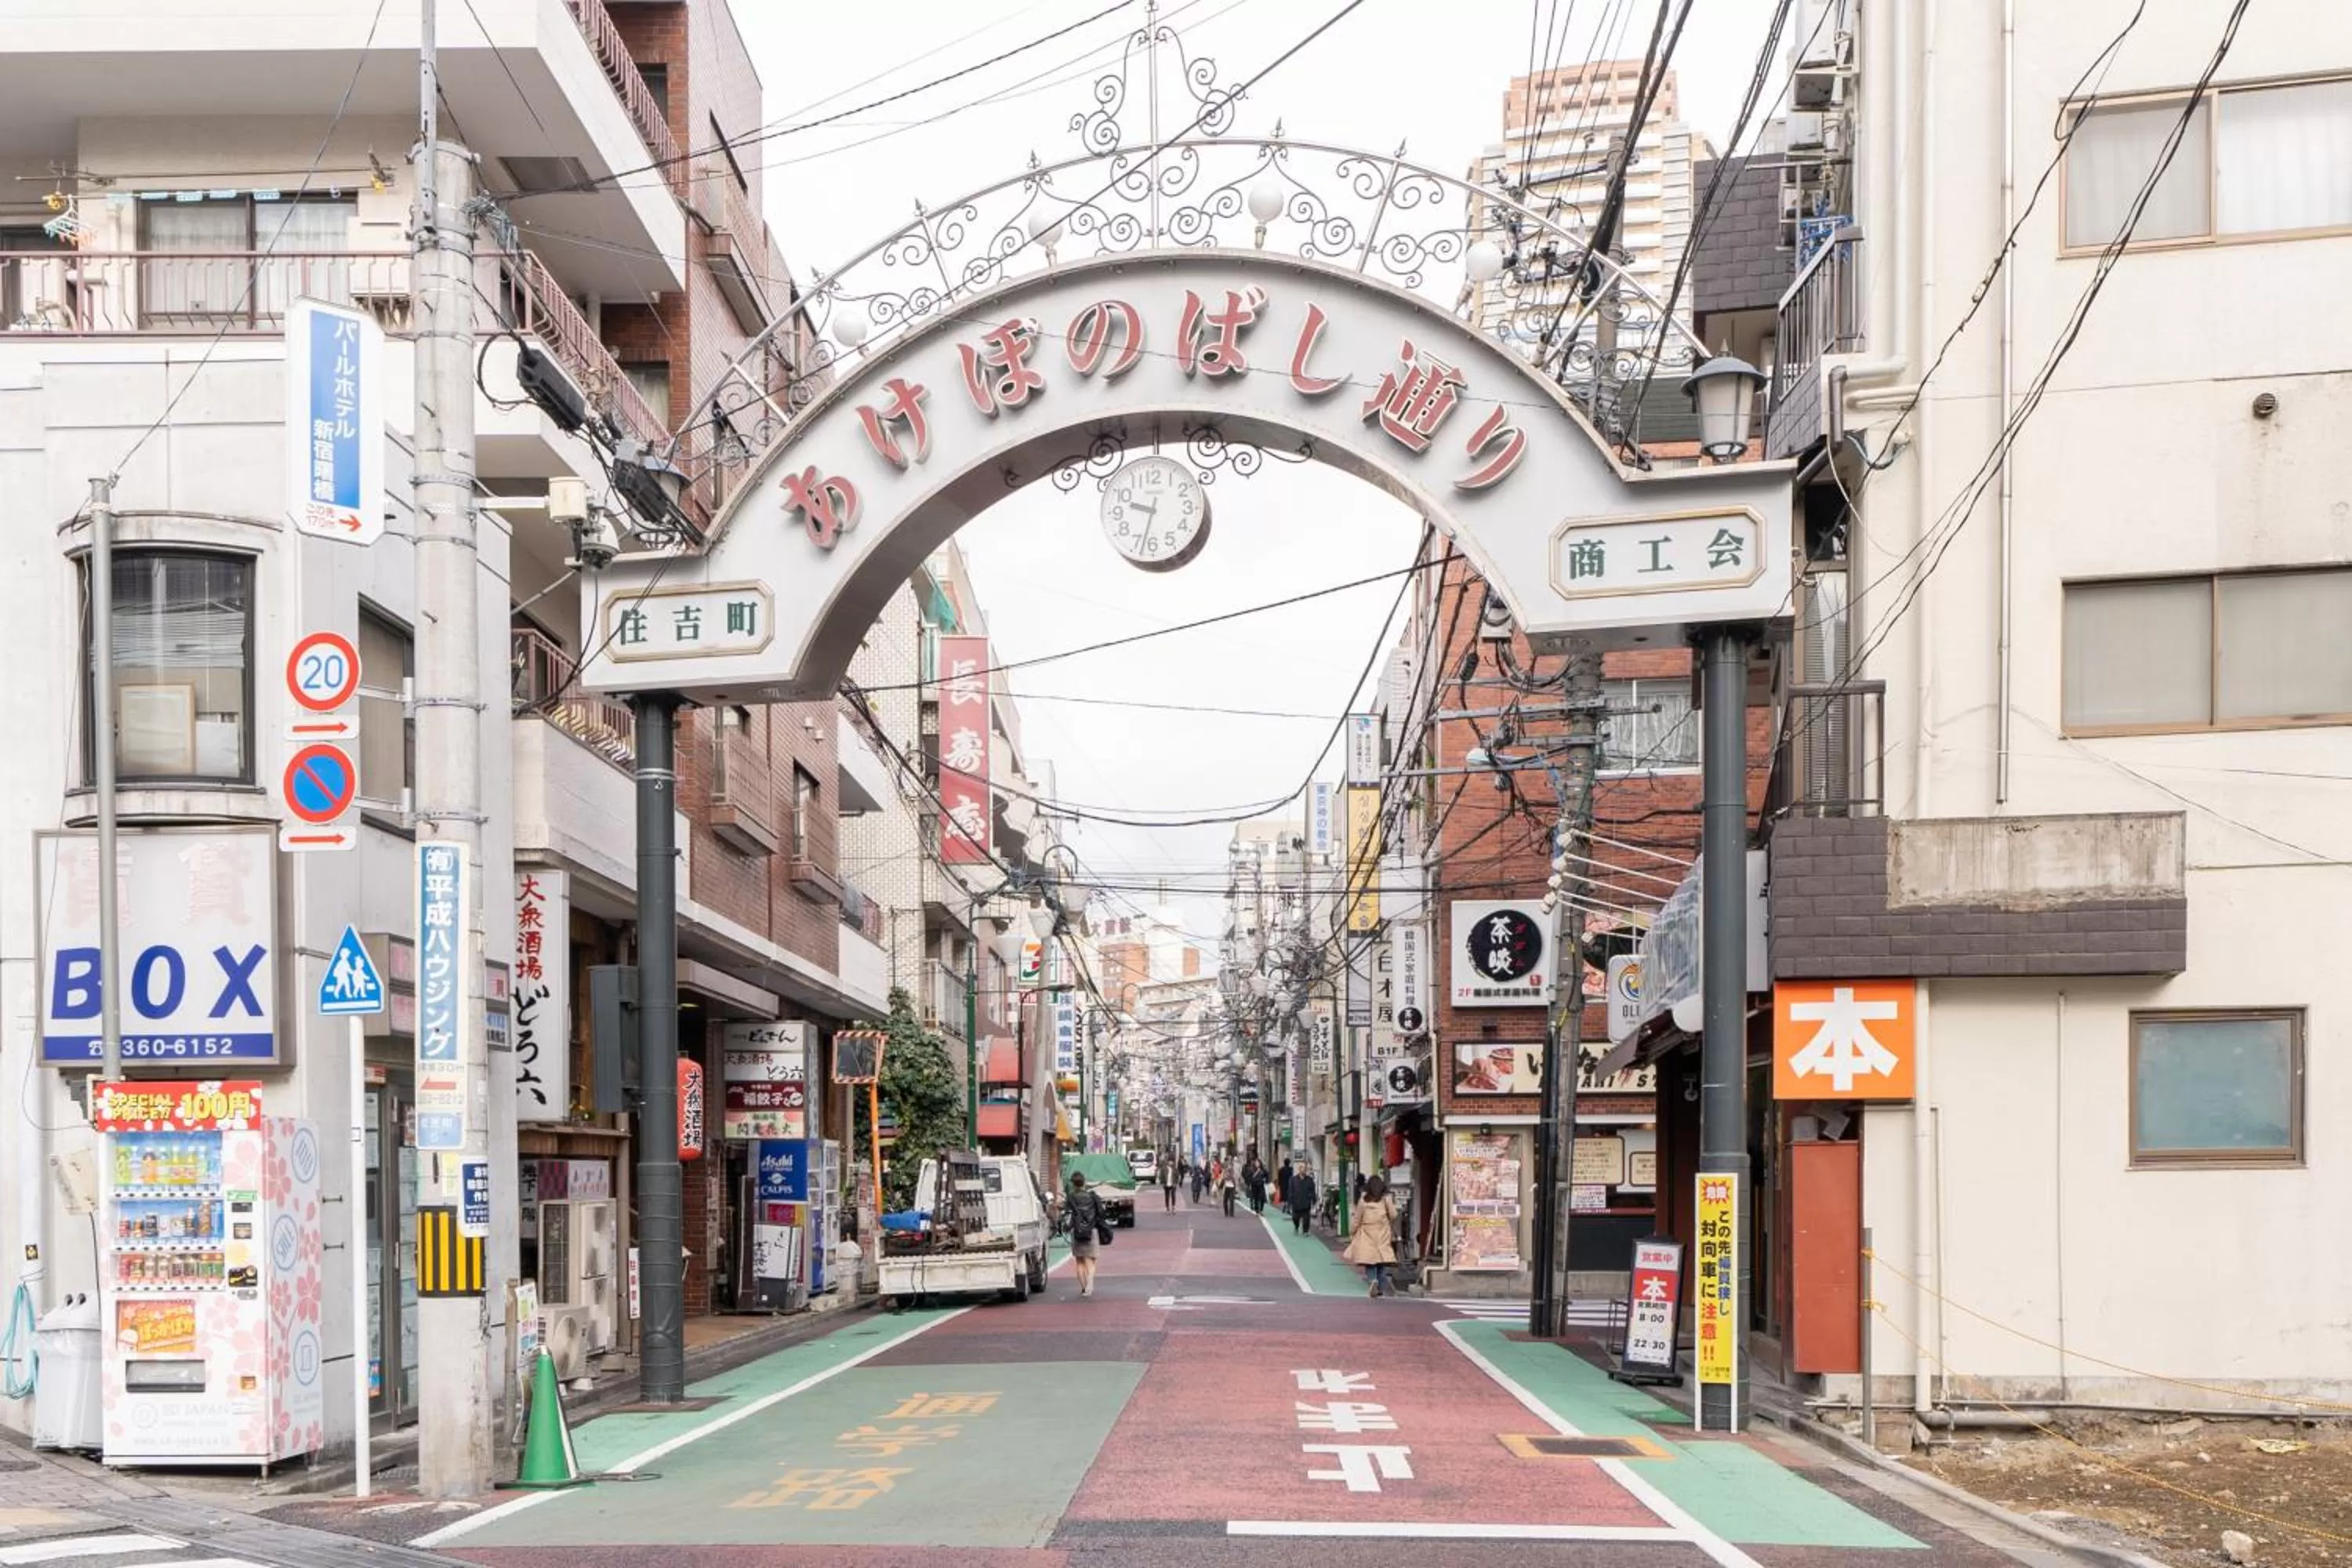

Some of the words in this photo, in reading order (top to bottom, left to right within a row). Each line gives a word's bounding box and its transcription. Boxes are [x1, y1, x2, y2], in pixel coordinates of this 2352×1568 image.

[334, 320, 358, 440] パールホテル
[780, 284, 1530, 550] あけぼのばし通り
[1130, 471, 1142, 489] 11
[1146, 470, 1162, 485] 12
[1117, 488, 1132, 503] 10
[1178, 482, 1189, 498] 2
[1112, 506, 1123, 521] 9
[1182, 500, 1194, 515] 3
[1119, 521, 1130, 536] 8
[1178, 518, 1189, 532] 4
[1132, 534, 1142, 549] 7
[1147, 537, 1158, 552] 6
[1164, 532, 1175, 546] 5
[1569, 528, 1744, 580] 商工会
[617, 601, 759, 646] 住吉町
[302, 655, 344, 690] 20
[514, 873, 545, 981] 大衆酒場
[51, 943, 268, 1020] BOX
[1458, 988, 1472, 997] 2F
[515, 984, 550, 1105] どろ六
[1788, 987, 1900, 1091] 本
[109, 1093, 176, 1106] SPECIAL
[181, 1091, 251, 1120] 100円
[760, 1154, 793, 1167] Asahi
[760, 1185, 793, 1196] CALPIS
[1641, 1252, 1674, 1264] 営業中
[1641, 1276, 1668, 1302] 本
[1633, 1339, 1666, 1350] 22:30
[721, 1392, 1004, 1510] 通学路
